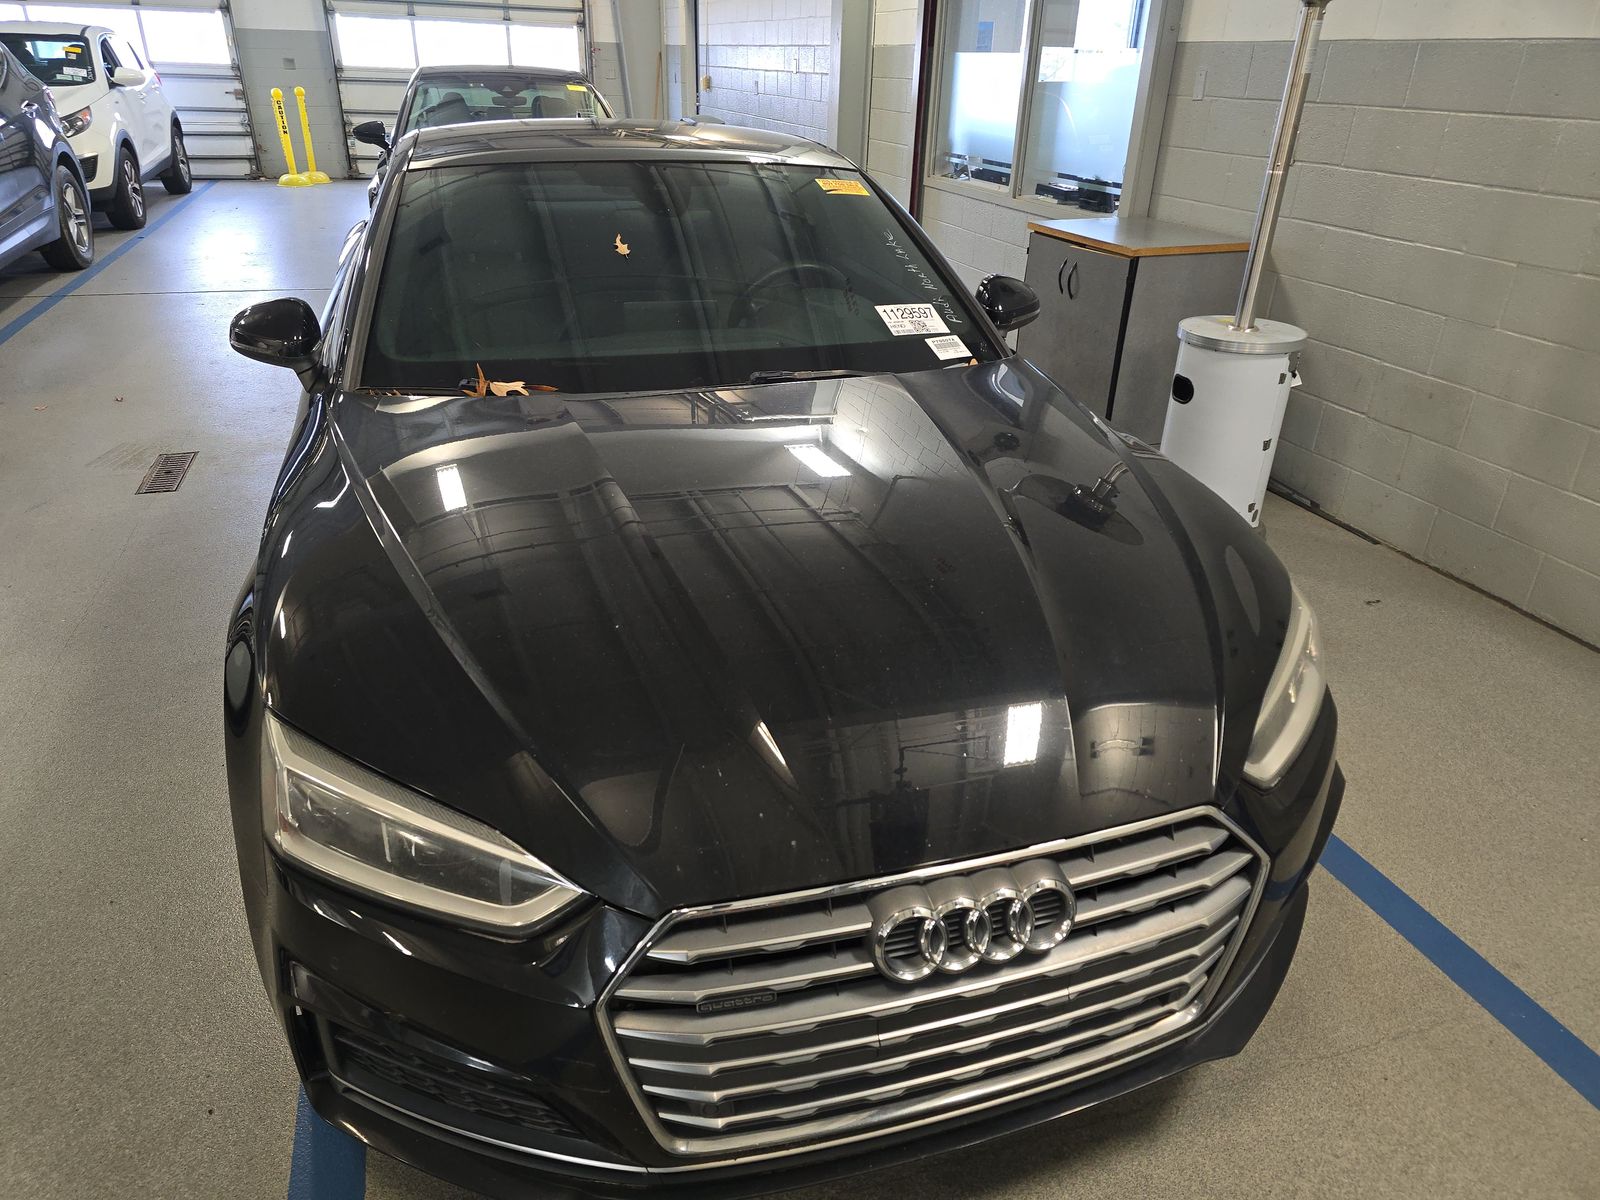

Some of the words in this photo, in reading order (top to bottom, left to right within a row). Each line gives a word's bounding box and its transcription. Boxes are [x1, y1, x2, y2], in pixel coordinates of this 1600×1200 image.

[276, 100, 288, 134] CAUTION
[882, 307, 933, 320] 1129597
[699, 995, 773, 1012] quattro
